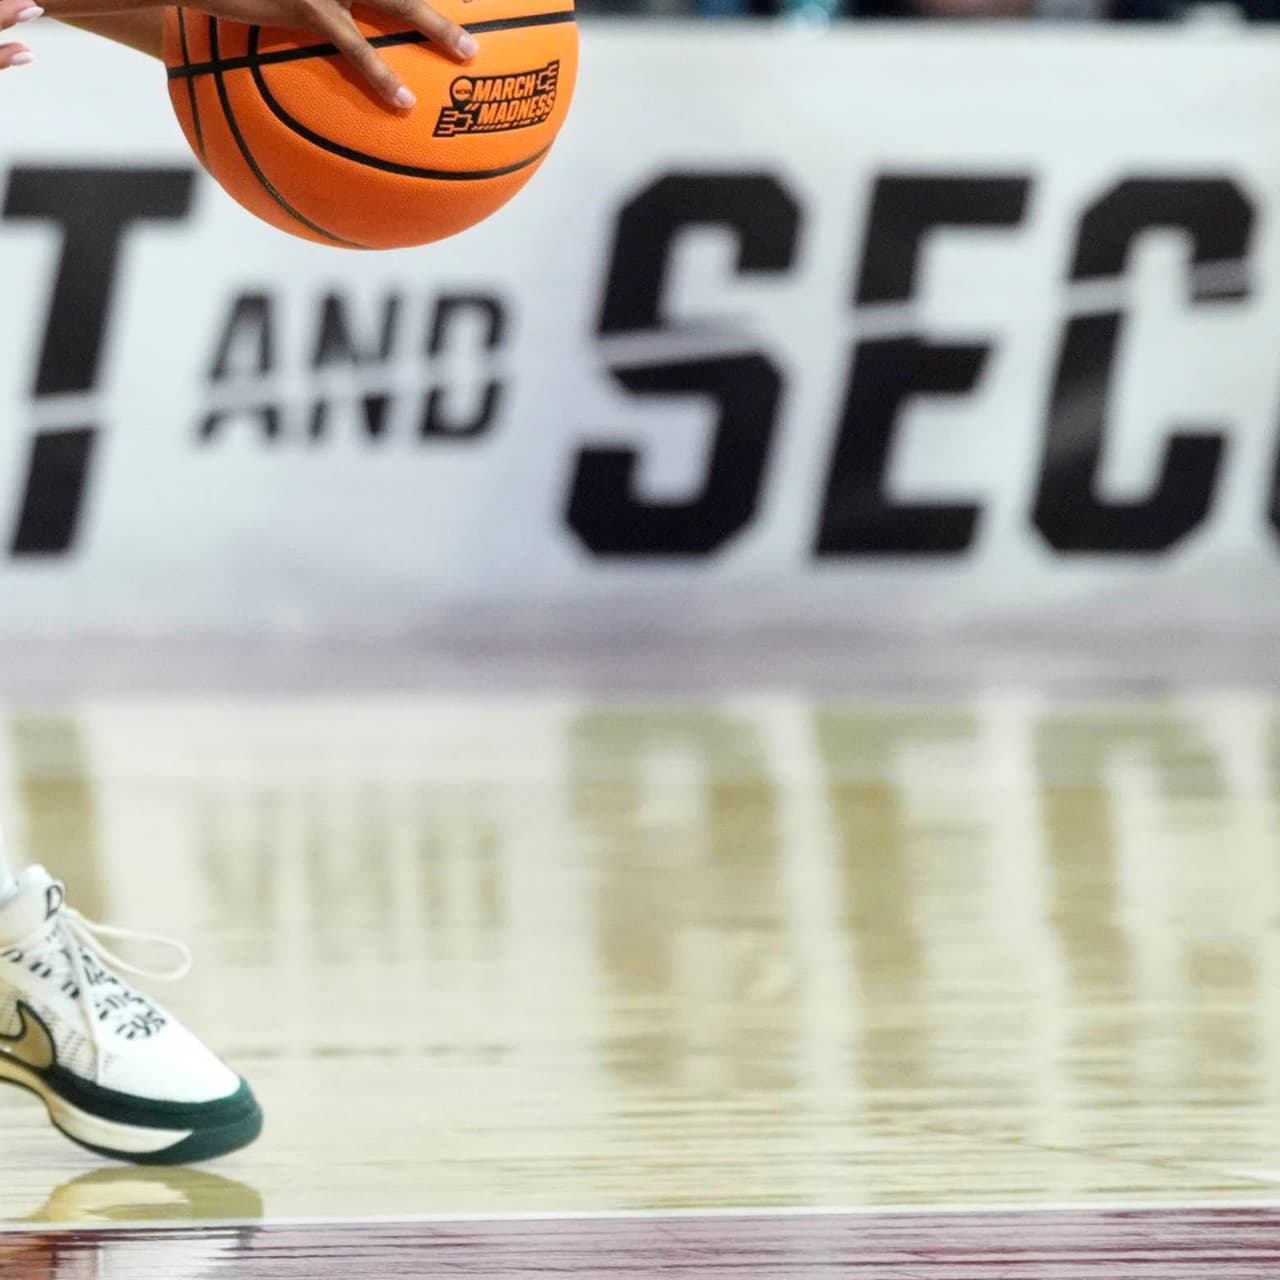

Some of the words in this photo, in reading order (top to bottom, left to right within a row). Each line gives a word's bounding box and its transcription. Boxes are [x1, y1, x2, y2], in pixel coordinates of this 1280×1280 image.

[473, 73, 537, 102] MARCH
[476, 91, 556, 125] MADNESS
[195, 290, 512, 444] AND
[562, 170, 1280, 562] SEC
